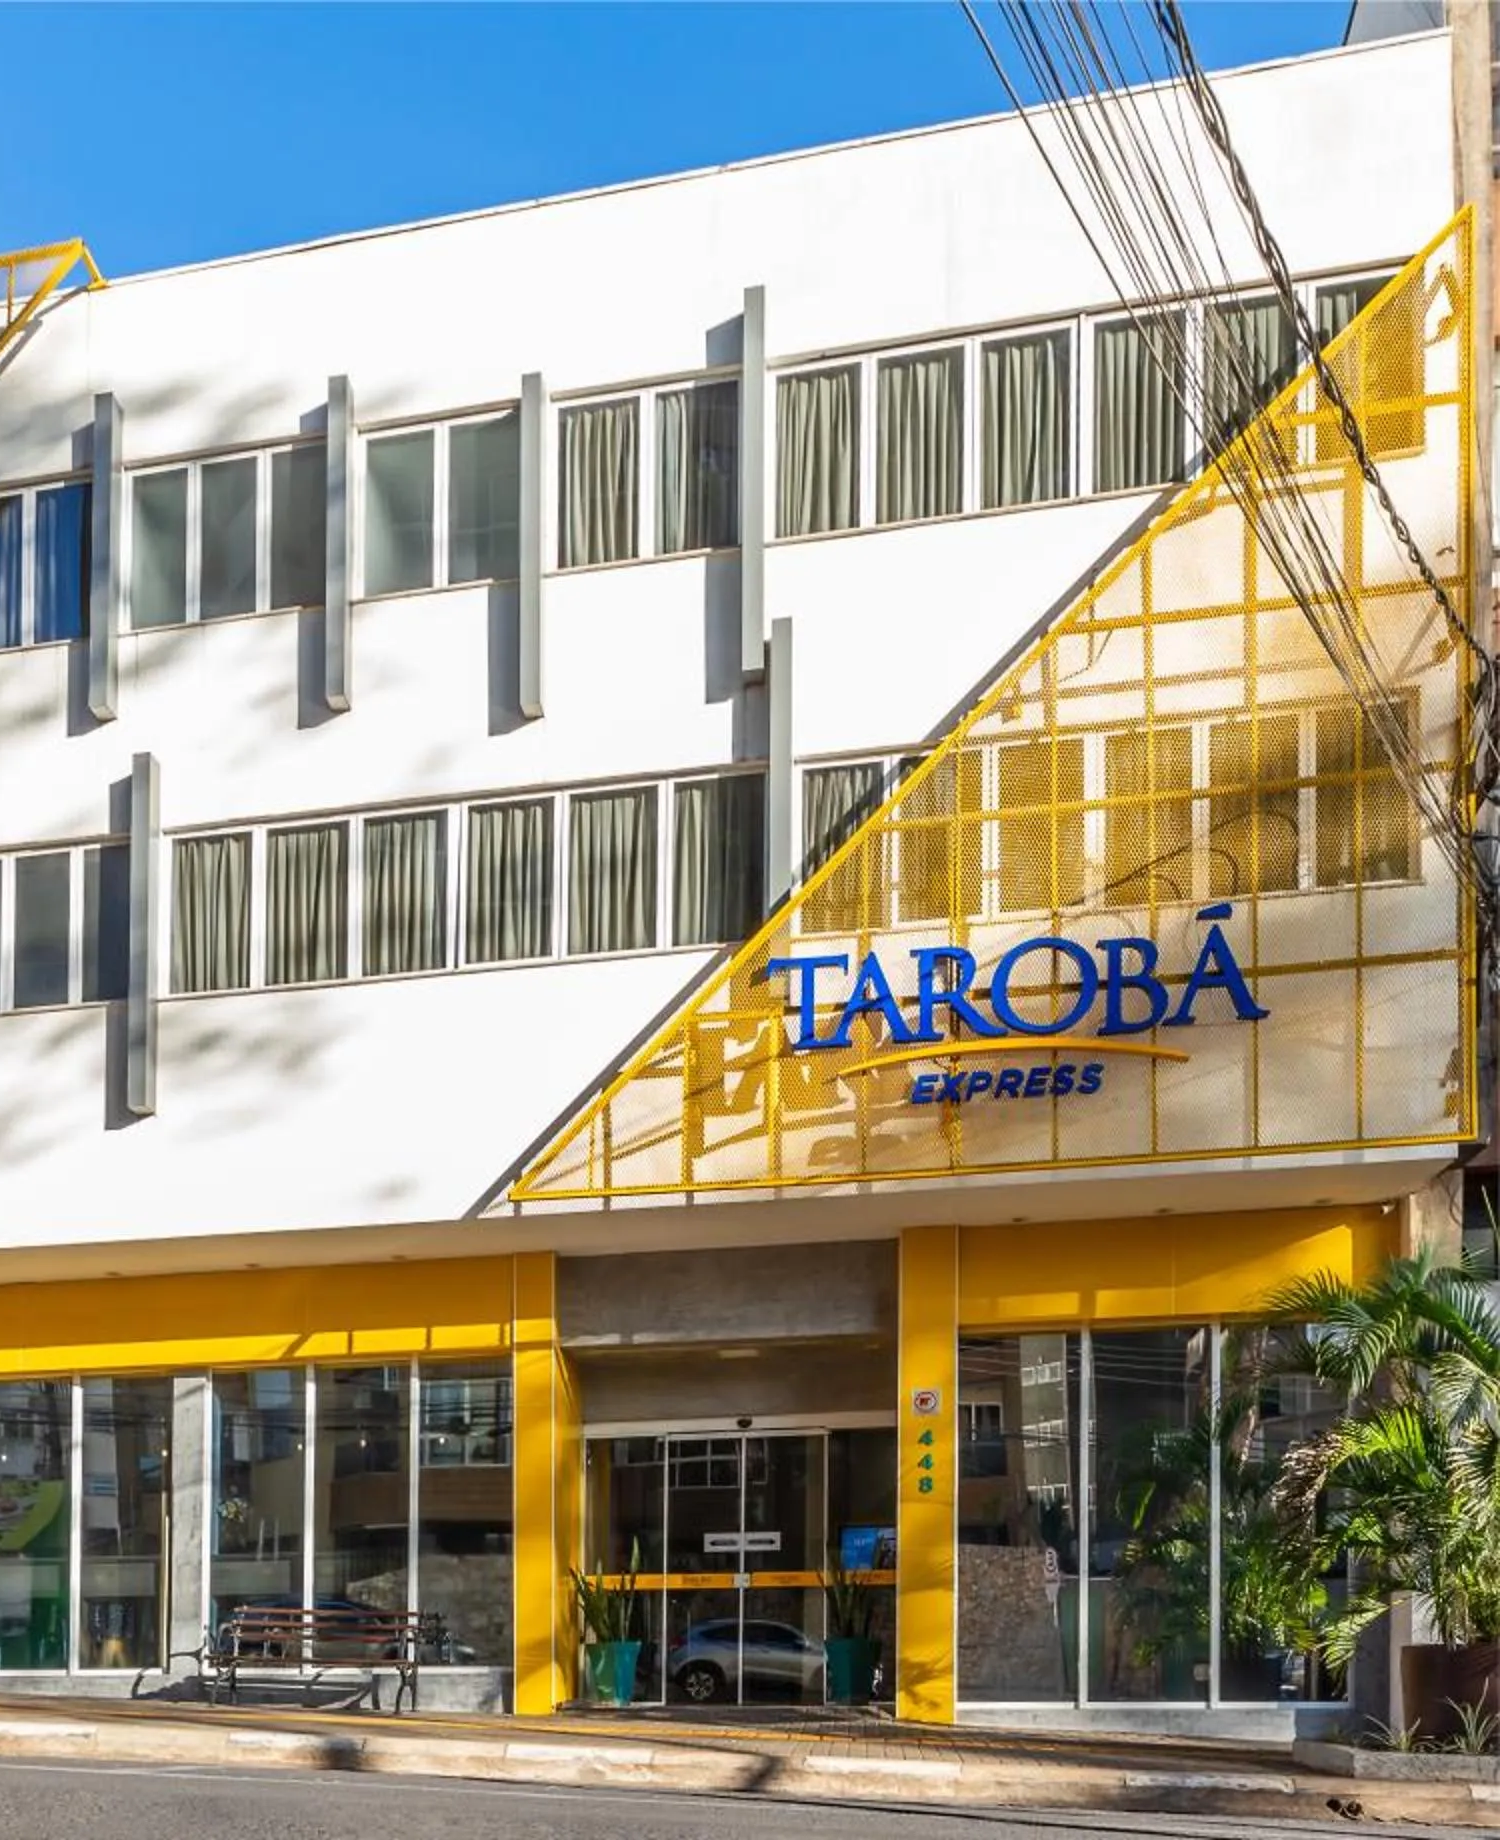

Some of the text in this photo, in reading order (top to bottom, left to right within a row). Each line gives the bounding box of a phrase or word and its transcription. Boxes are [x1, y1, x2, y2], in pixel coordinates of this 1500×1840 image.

[767, 903, 1270, 1050] TAROBÁ
[910, 1062, 1103, 1104] EXPRESS
[917, 1429, 934, 1494] 448
